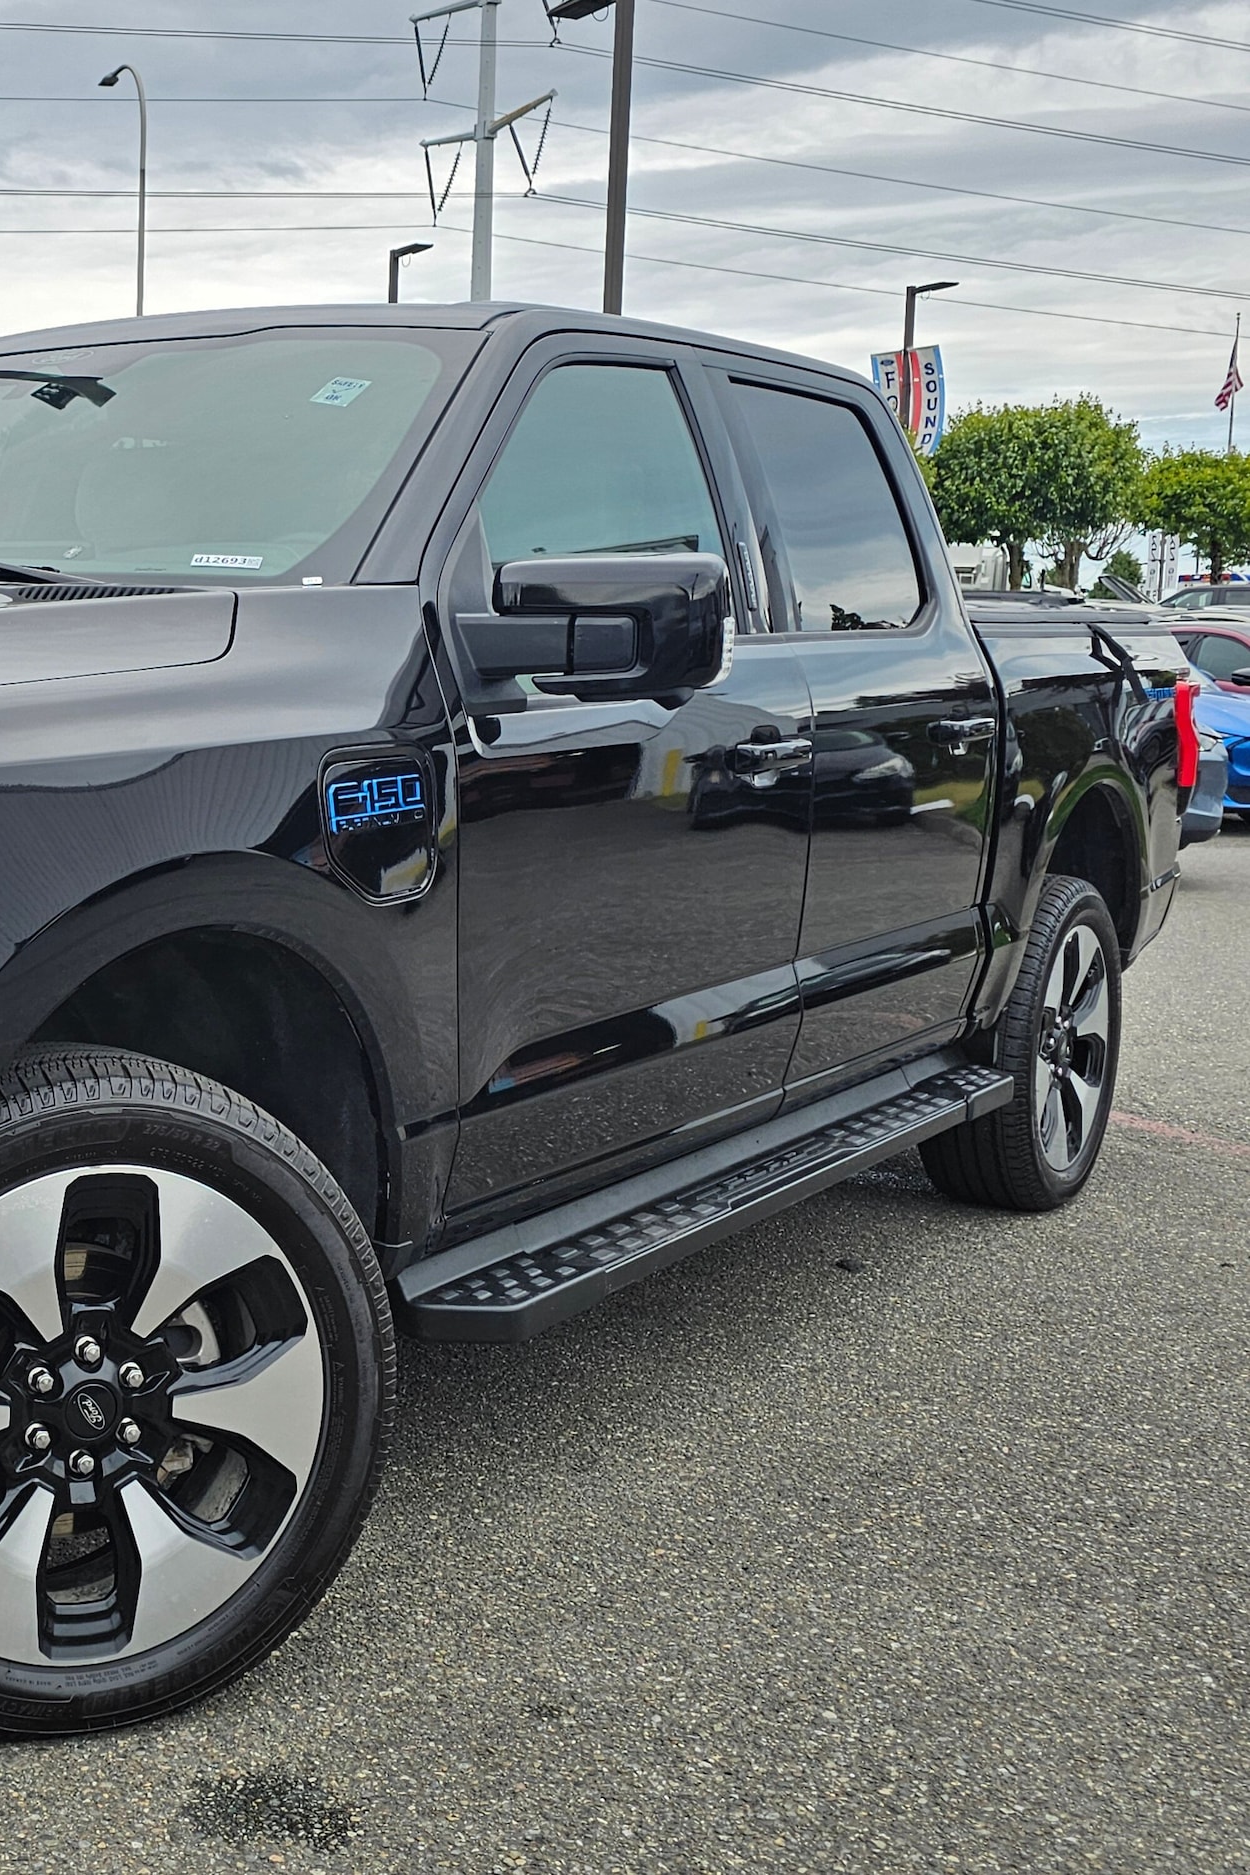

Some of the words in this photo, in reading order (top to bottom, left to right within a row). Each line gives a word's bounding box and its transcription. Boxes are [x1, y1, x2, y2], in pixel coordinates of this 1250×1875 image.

[325, 393, 342, 402] OK
[920, 361, 938, 446] SOUND
[193, 555, 248, 566] d12693
[81, 1398, 103, 1425] Ford
